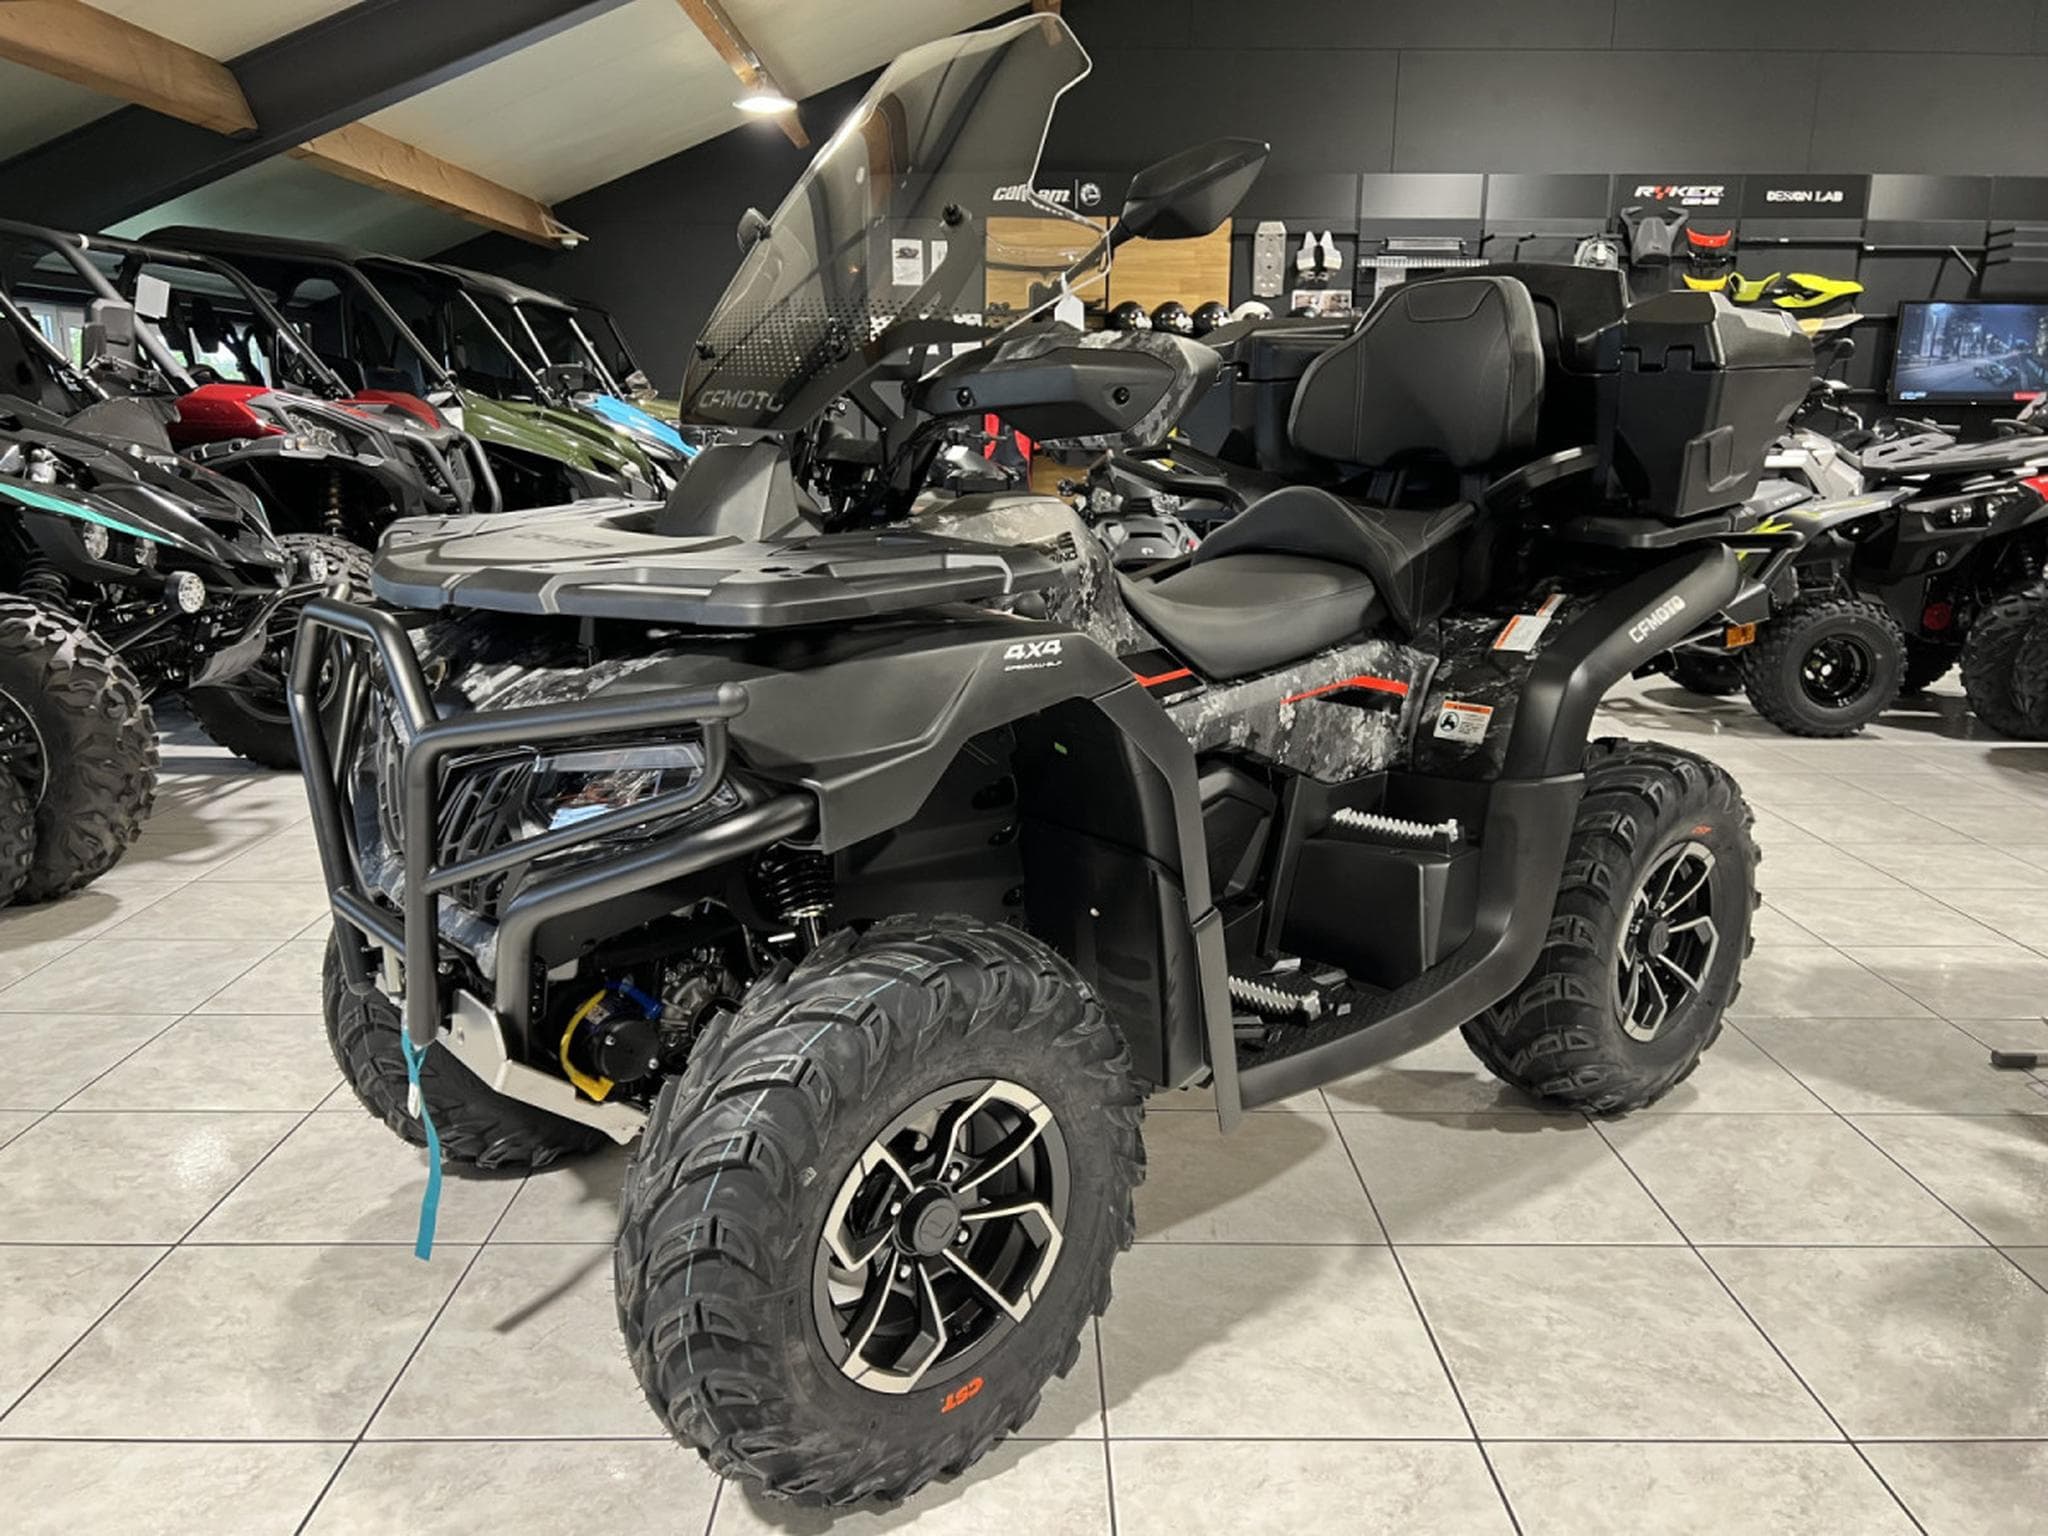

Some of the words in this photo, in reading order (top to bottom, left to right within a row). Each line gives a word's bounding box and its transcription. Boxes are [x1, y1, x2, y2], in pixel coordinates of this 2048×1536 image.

[1634, 185, 1725, 200] RYKER
[1766, 190, 1813, 202] DESIGN
[1814, 190, 1844, 202] LAB
[1628, 595, 1686, 643] CFMOTO
[941, 1376, 985, 1413] CST
